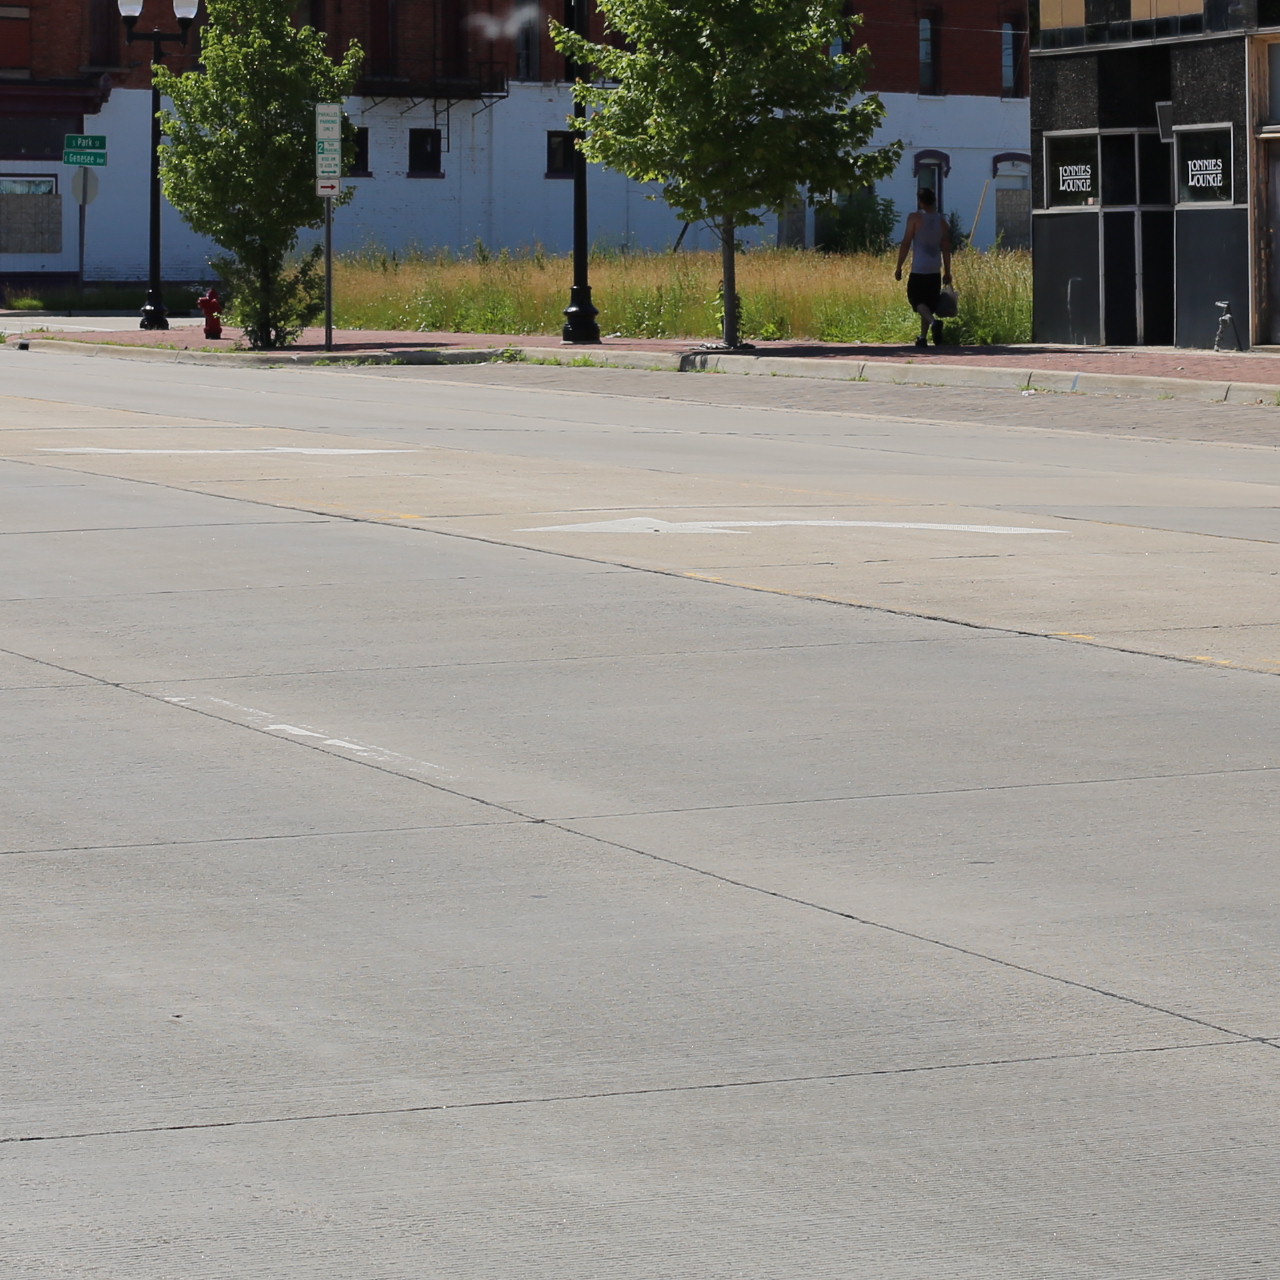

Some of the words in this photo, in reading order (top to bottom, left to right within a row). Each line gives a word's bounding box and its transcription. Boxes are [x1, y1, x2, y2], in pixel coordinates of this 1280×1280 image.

[77, 137, 93, 147] Park
[318, 142, 323, 153] 2
[69, 153, 95, 163] Genesee
